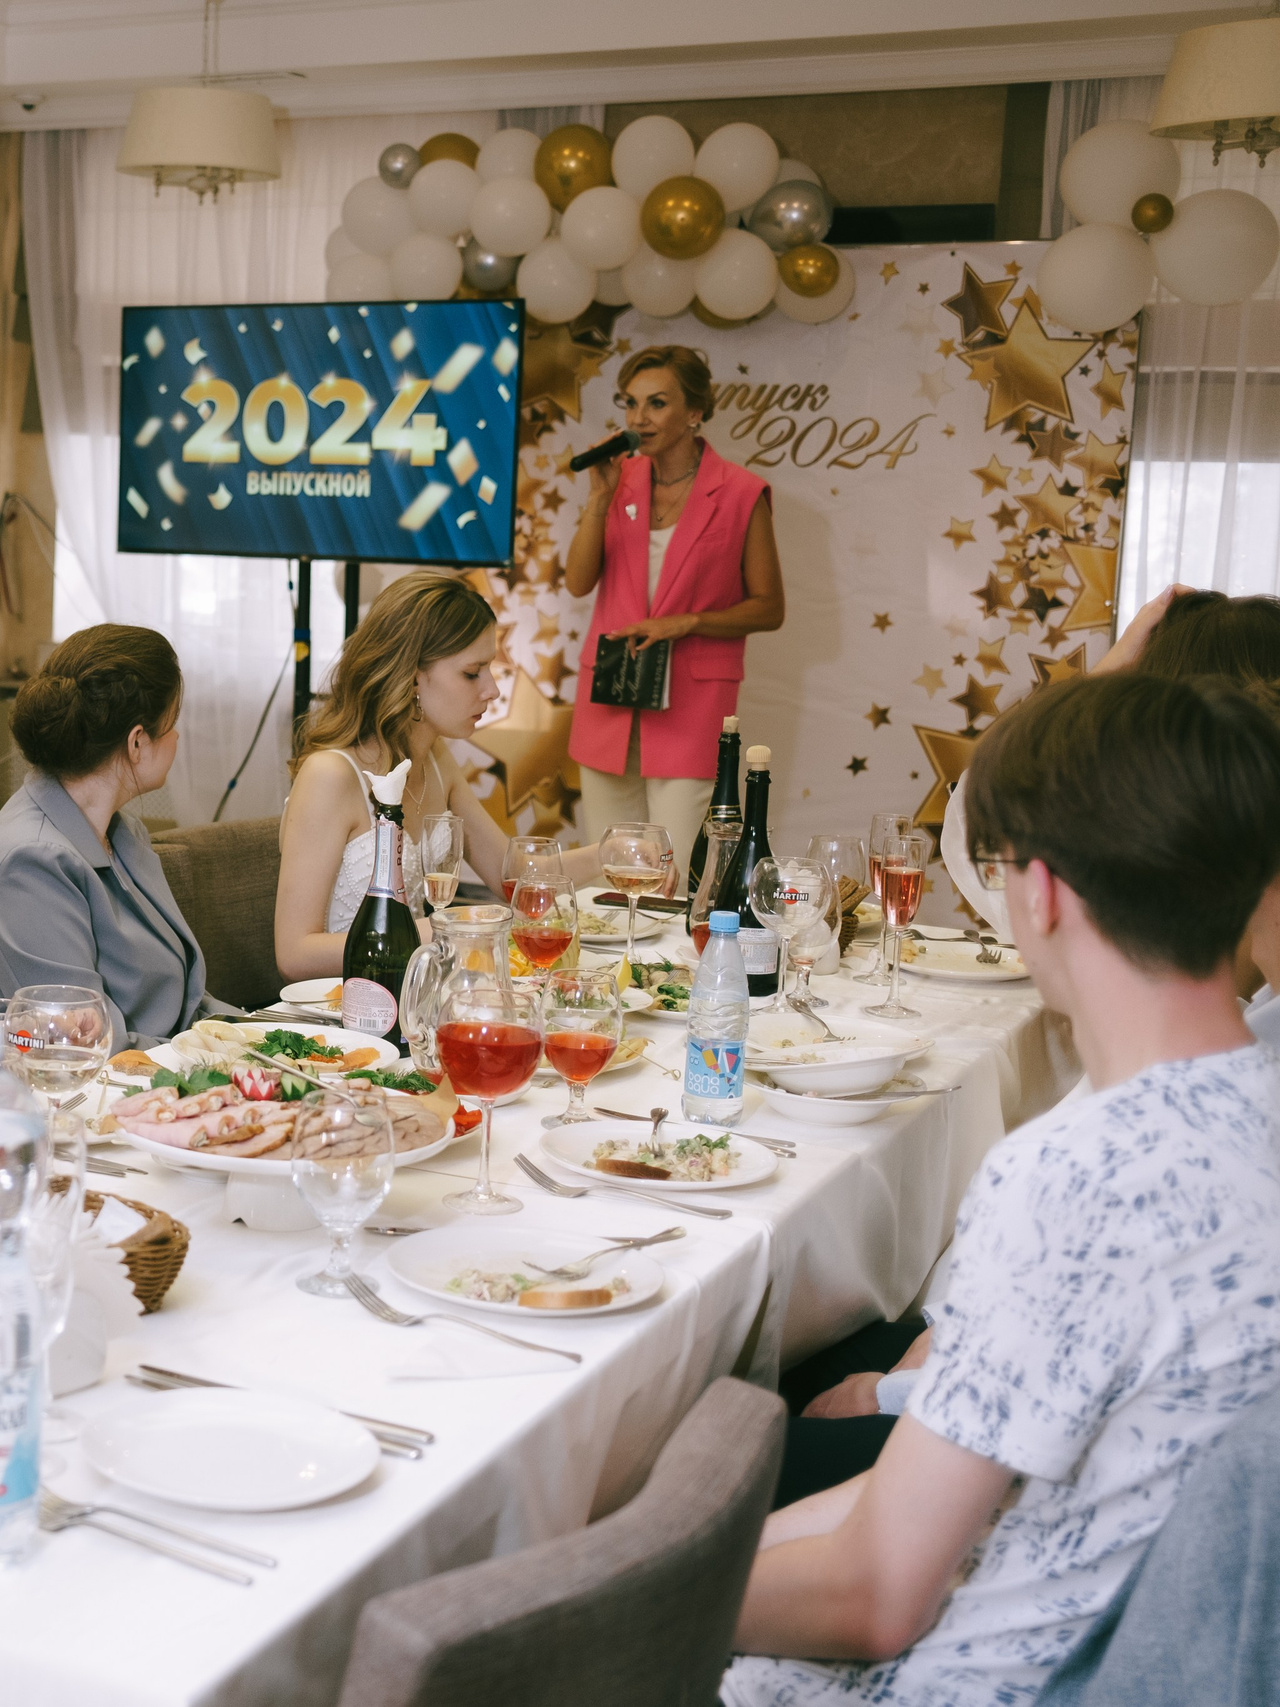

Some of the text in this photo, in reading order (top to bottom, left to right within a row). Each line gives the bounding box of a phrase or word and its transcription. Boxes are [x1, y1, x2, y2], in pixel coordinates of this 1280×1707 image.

[181, 377, 448, 467] 2024
[710, 382, 831, 441] пуск
[745, 413, 937, 470] 2024
[246, 470, 372, 498] ВЫПУСКНОЙ
[772, 891, 808, 901] MARTINI
[8, 1032, 44, 1049] MARTINI
[687, 1081, 719, 1095] aqua
